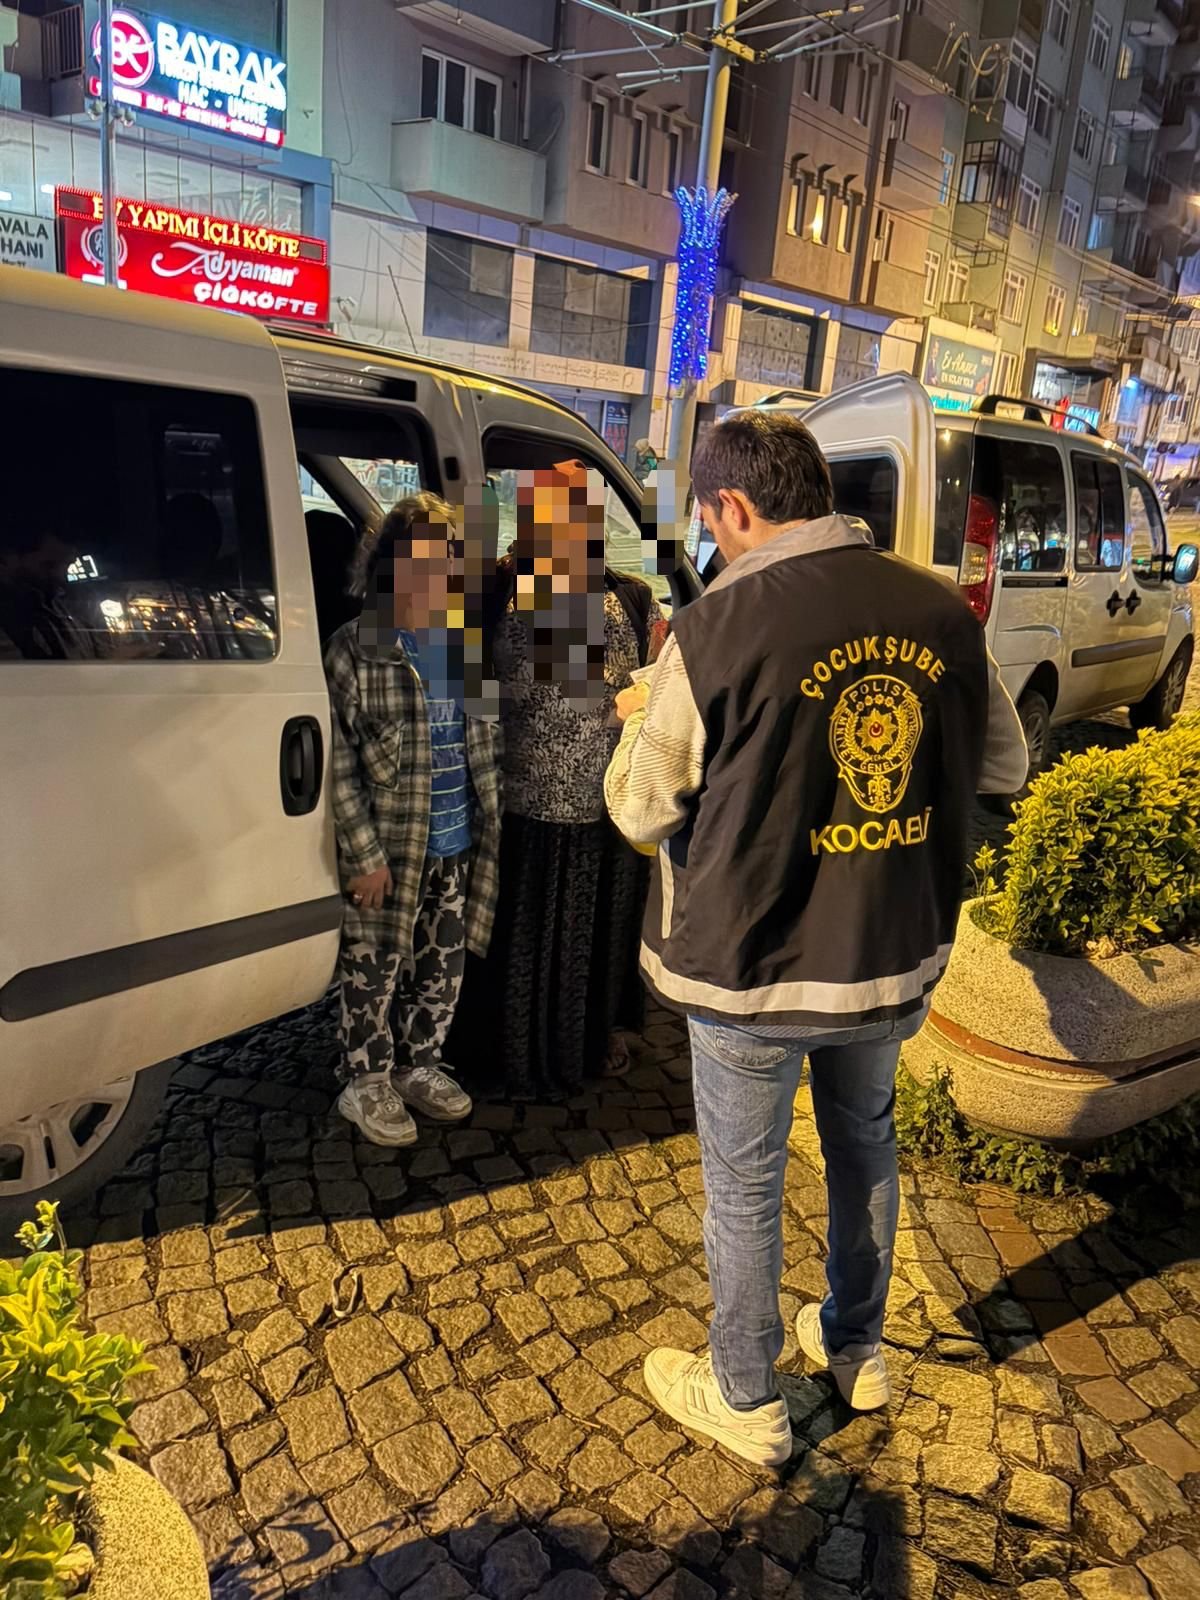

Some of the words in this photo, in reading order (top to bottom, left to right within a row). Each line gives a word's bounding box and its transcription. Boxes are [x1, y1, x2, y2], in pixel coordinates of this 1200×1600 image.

[157, 21, 287, 94] BAYRAK
[0, 217, 48, 240] VALA
[128, 204, 200, 239] YAPIMI
[203, 216, 240, 246] İÇLİ
[243, 228, 300, 258] KÖFTE
[1, 237, 43, 259] HANI
[801, 636, 880, 699] ÇOCUK
[884, 636, 946, 683] ŞUBE
[849, 679, 901, 702] POLİS
[860, 760, 897, 773] GENEL
